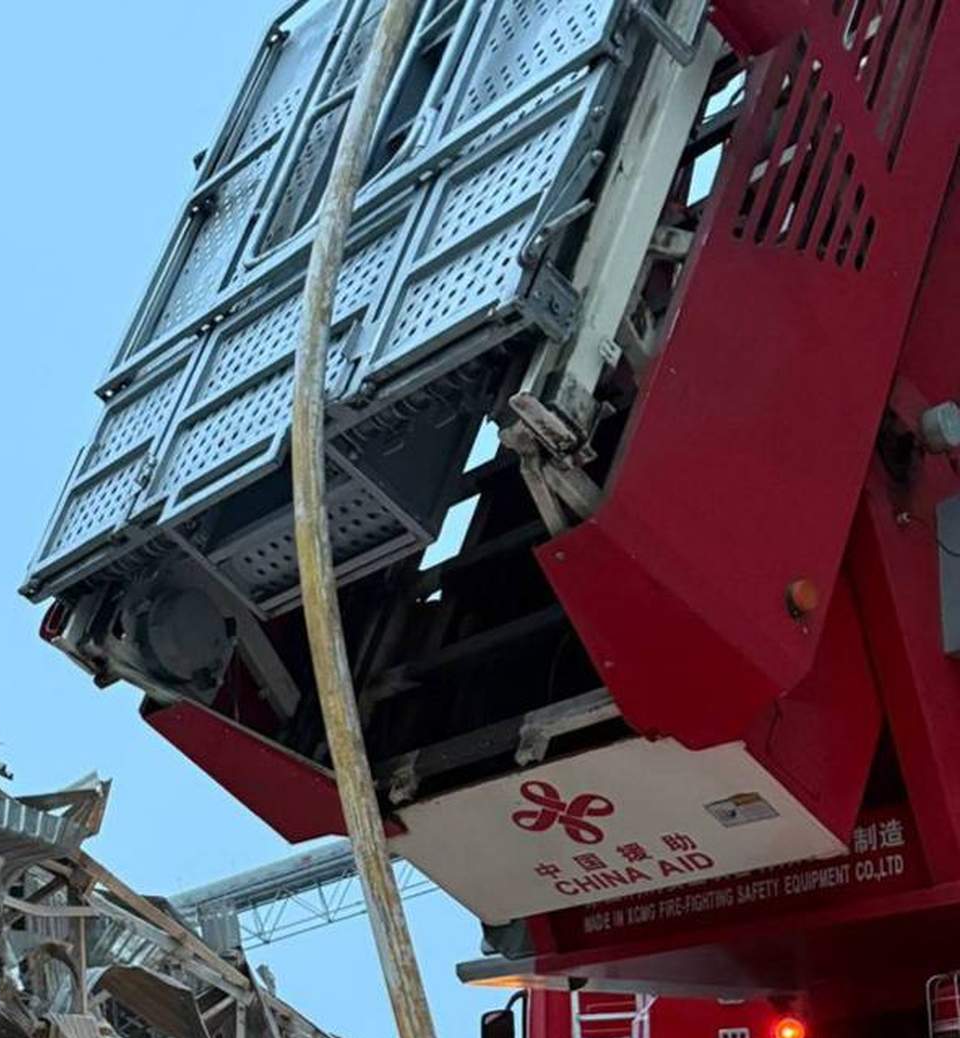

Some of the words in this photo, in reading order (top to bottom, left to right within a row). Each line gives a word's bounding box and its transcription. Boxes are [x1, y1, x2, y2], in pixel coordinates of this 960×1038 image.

[534, 832, 698, 879] 中国援助
[852, 819, 906, 853] 制造
[555, 865, 652, 895] CHINA
[658, 851, 714, 877] AID
[736, 878, 780, 904] SAFETY
[783, 864, 851, 895] EQUIPMENT
